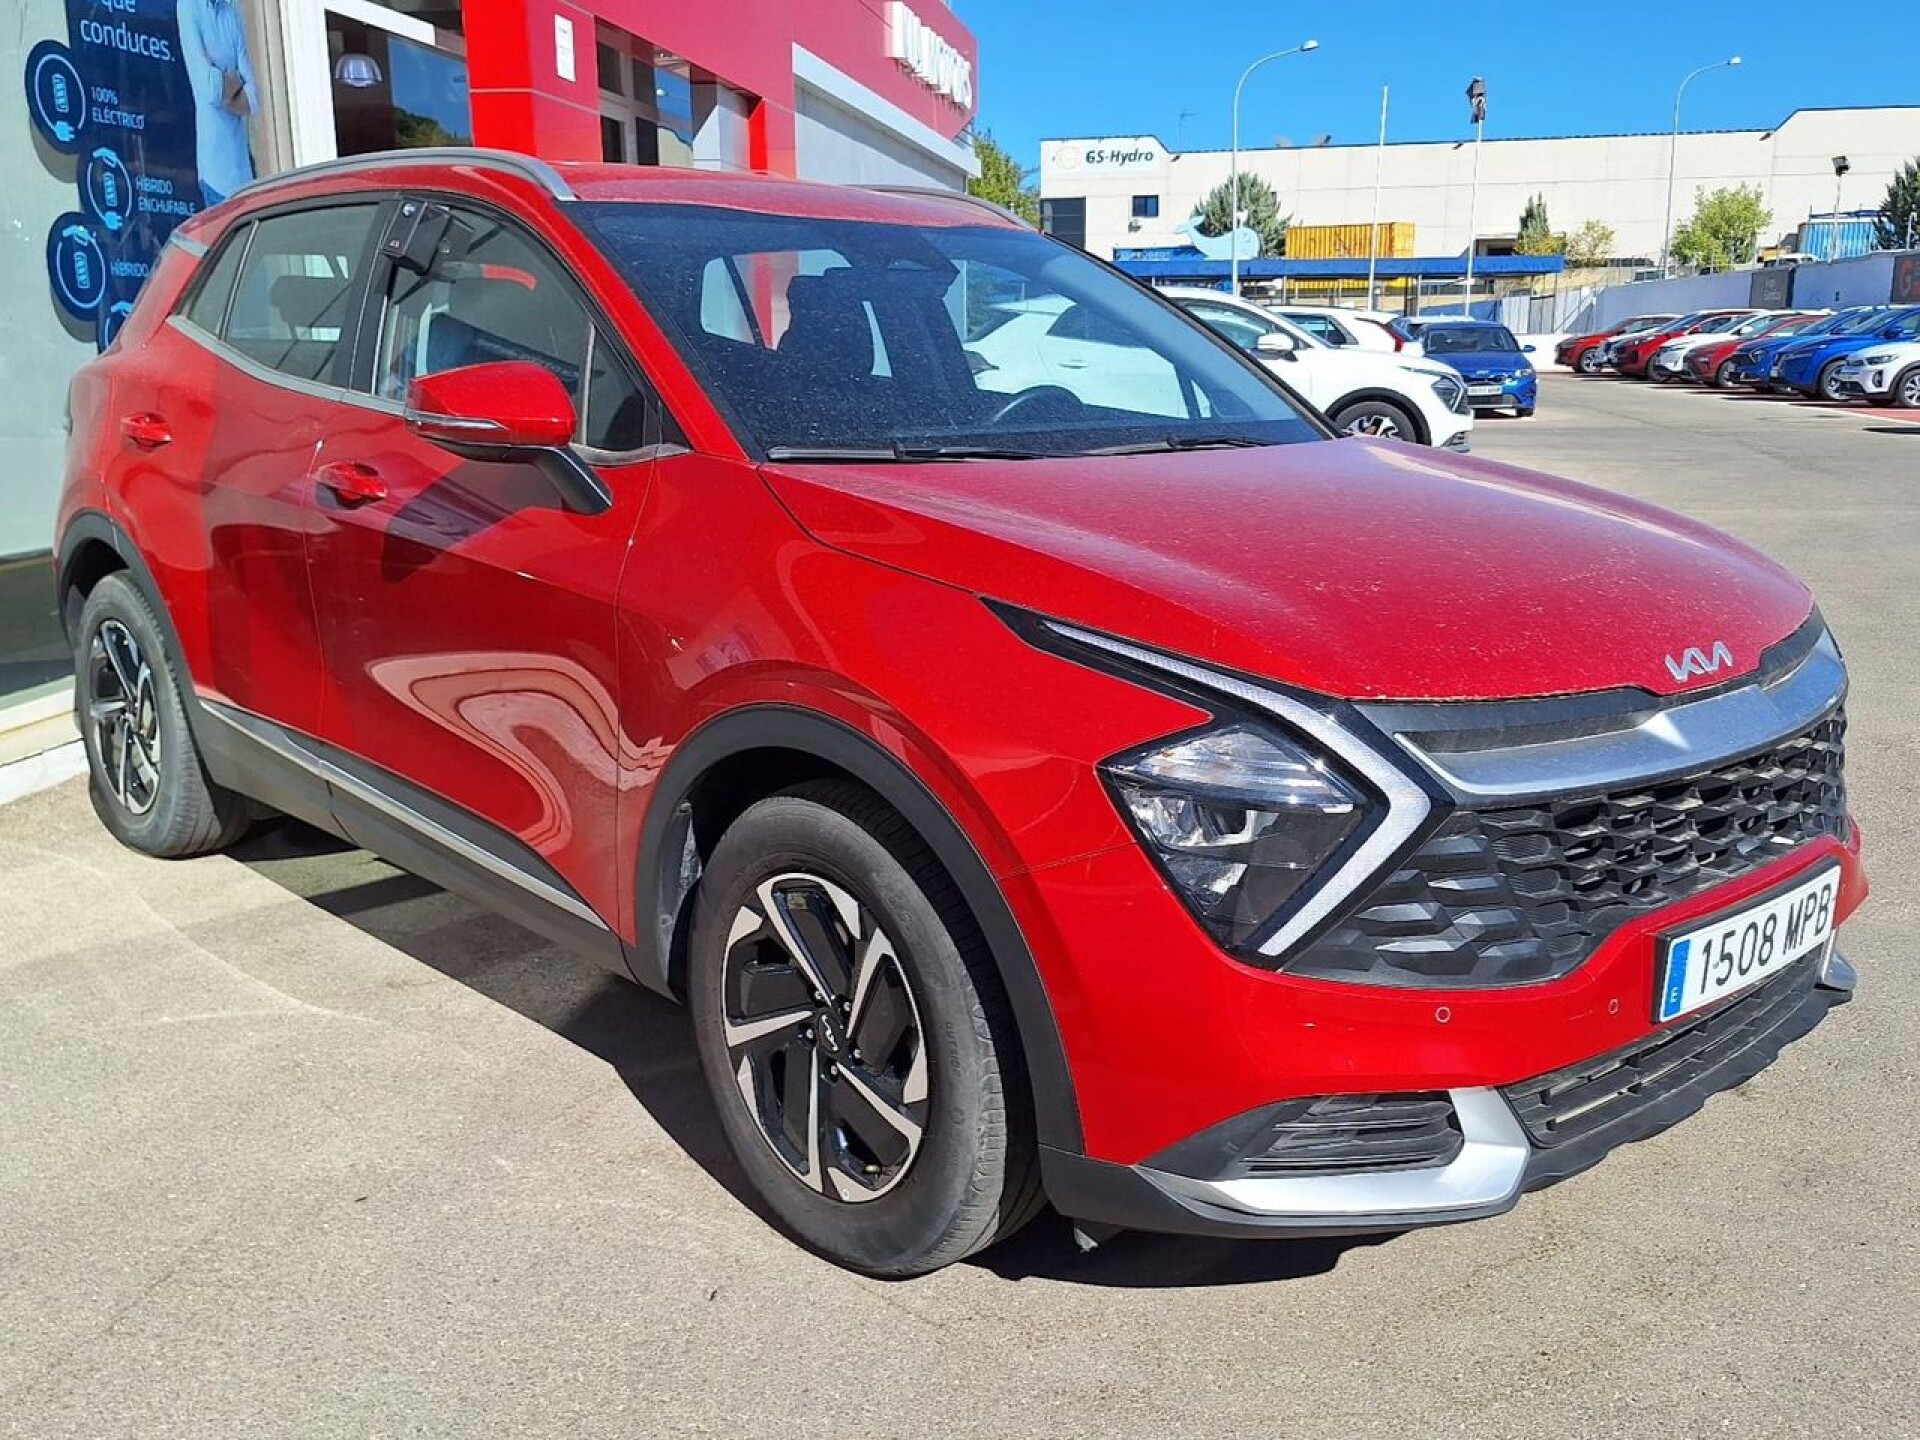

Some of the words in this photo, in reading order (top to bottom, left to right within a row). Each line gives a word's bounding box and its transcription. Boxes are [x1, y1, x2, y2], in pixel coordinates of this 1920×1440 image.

[80, 20, 175, 62] conduces.
[91, 86, 118, 105] 100%
[1085, 147, 1154, 167] GS-Hydro
[1664, 641, 1733, 684] KIA
[1700, 912, 1778, 994] 1508
[1783, 882, 1832, 955] MPB
